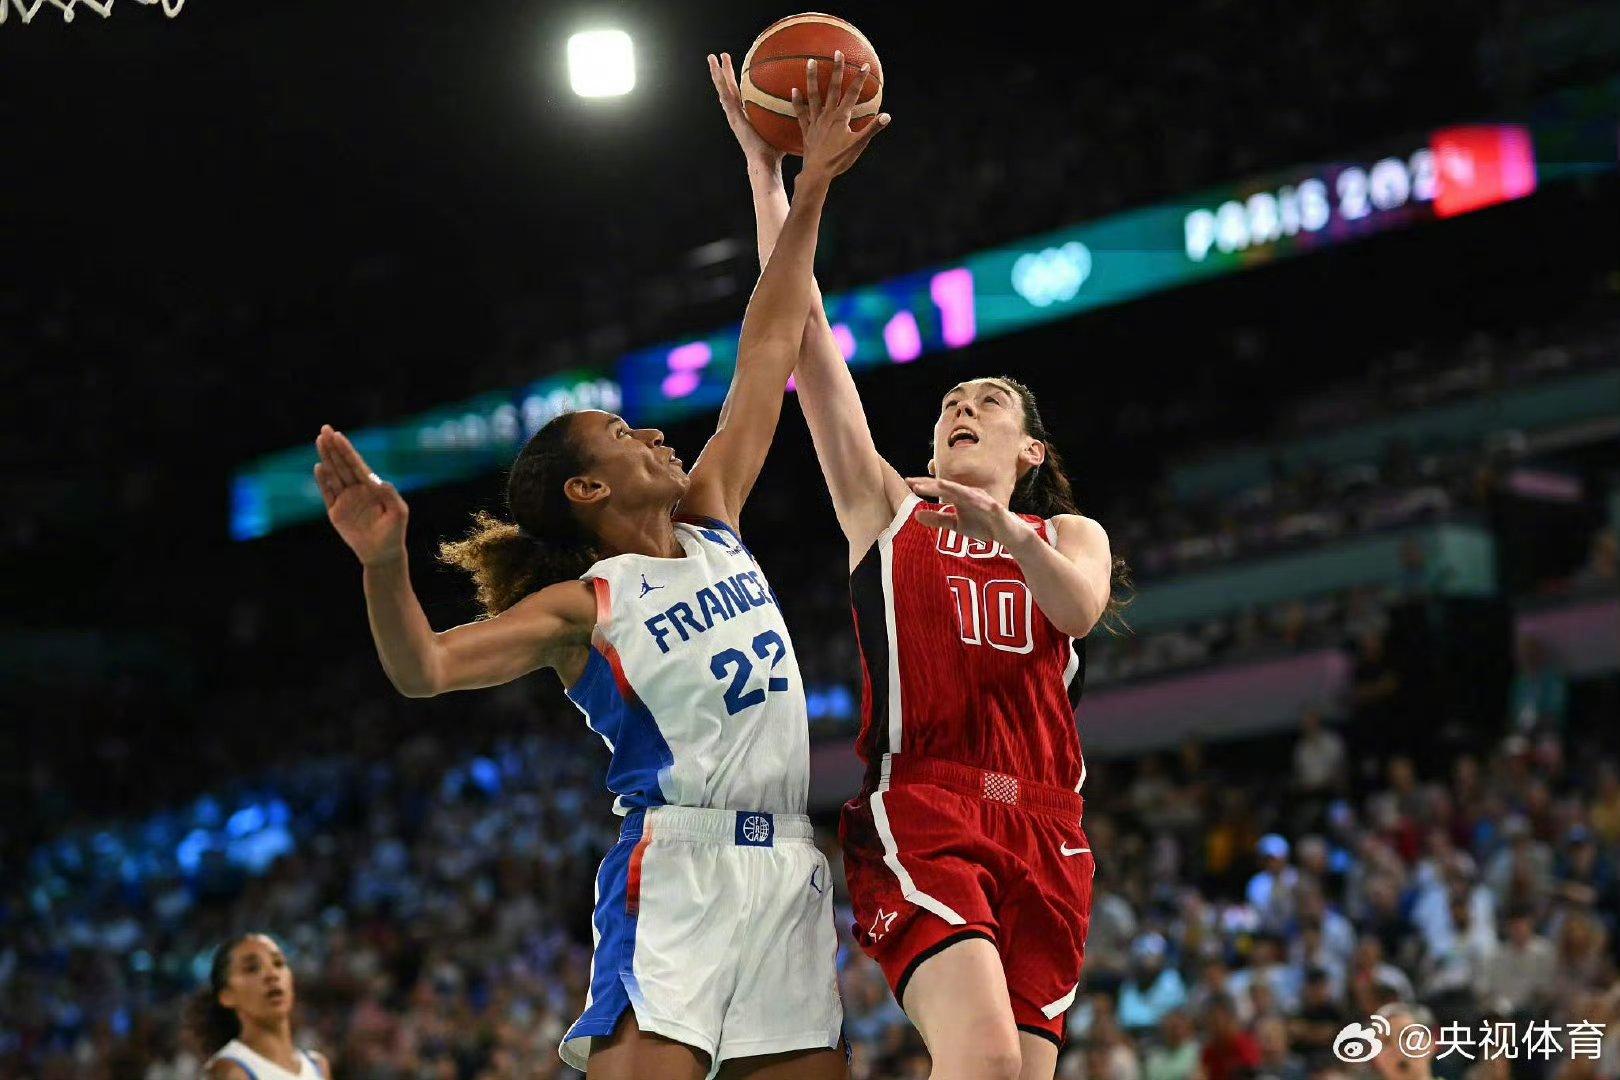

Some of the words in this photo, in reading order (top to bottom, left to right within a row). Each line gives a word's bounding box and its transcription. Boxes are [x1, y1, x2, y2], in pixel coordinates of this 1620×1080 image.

[1184, 177, 1329, 262] PARIS
[644, 570, 773, 654] FRANCE
[946, 575, 1034, 654] 10
[709, 629, 788, 716] 22
